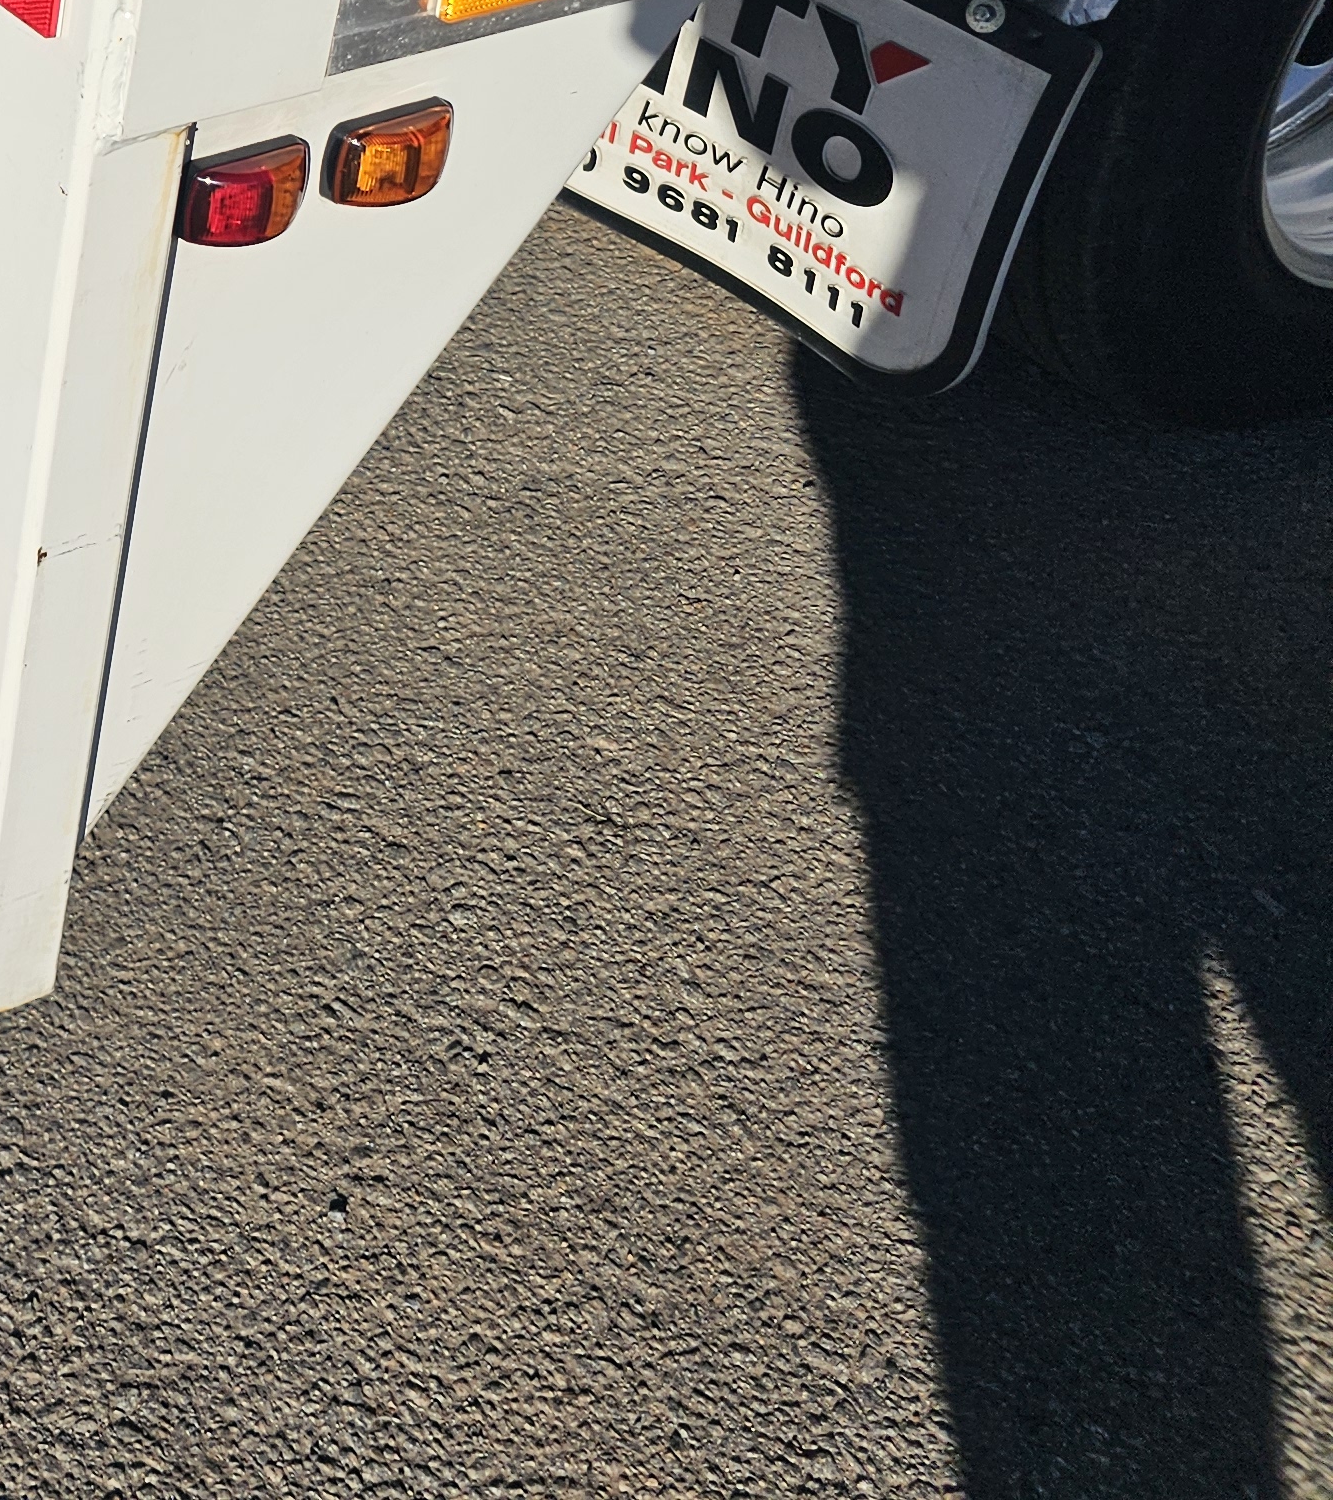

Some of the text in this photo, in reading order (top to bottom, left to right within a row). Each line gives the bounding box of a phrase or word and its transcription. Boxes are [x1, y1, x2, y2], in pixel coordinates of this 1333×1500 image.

[623, 165, 864, 328] 9681 8111
[629, 131, 709, 192] Park
[746, 196, 904, 317] Guildford
[638, 99, 844, 238] know Hino
